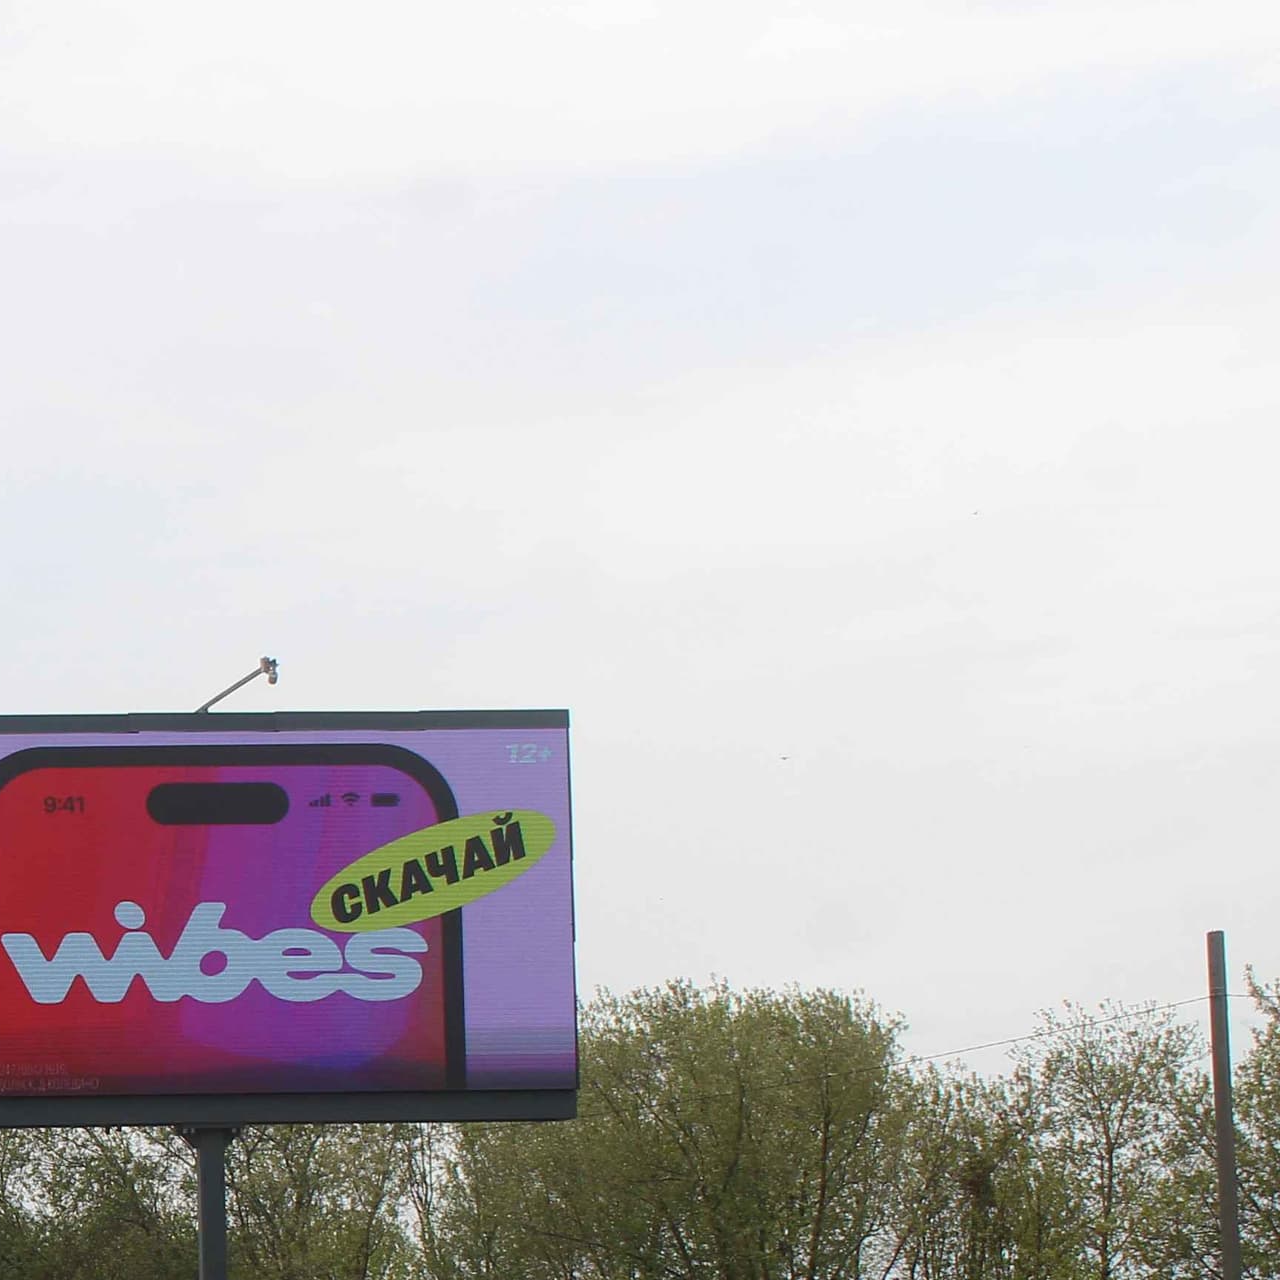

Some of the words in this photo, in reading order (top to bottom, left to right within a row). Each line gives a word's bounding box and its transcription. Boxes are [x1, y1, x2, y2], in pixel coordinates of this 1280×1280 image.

[43, 795, 86, 814] 9:41
[330, 811, 528, 924] СКАЧАЙ
[0, 901, 429, 1004] wibes
